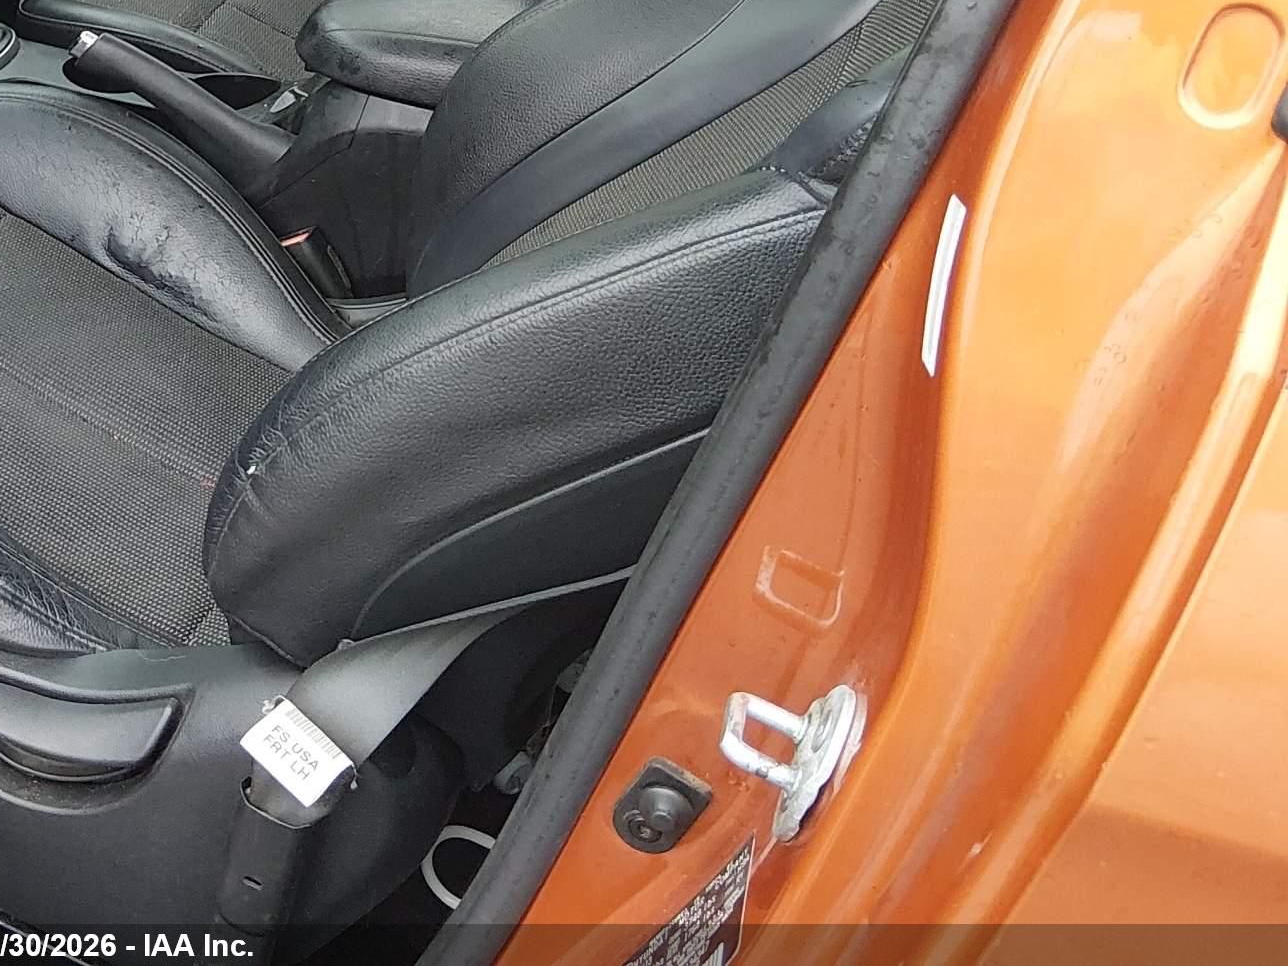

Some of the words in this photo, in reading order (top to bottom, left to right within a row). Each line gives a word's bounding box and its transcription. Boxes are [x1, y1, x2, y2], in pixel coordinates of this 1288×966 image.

[263, 733, 291, 760] FRT
[289, 760, 311, 780] LH
[272, 724, 291, 743] FS
[291, 742, 319, 771] USA
